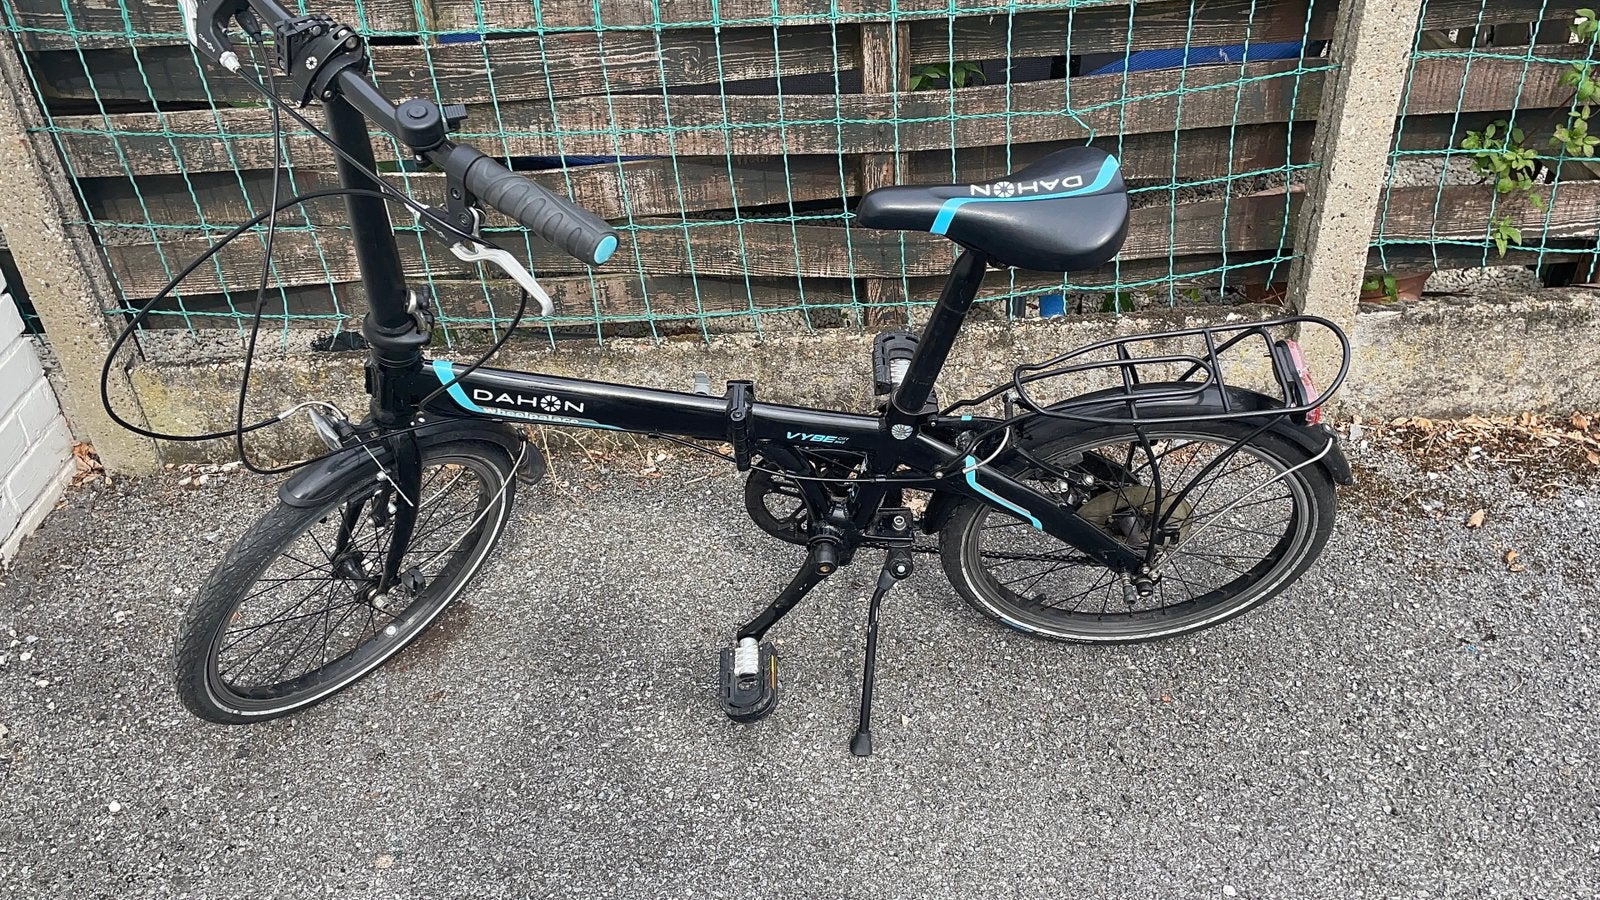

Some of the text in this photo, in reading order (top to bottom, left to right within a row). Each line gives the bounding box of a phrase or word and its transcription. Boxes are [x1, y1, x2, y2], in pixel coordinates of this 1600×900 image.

[970, 175, 1084, 198] DAHON
[473, 388, 585, 413] DAHON
[483, 407, 580, 424] wheelpalace
[787, 431, 838, 443] VYBE
